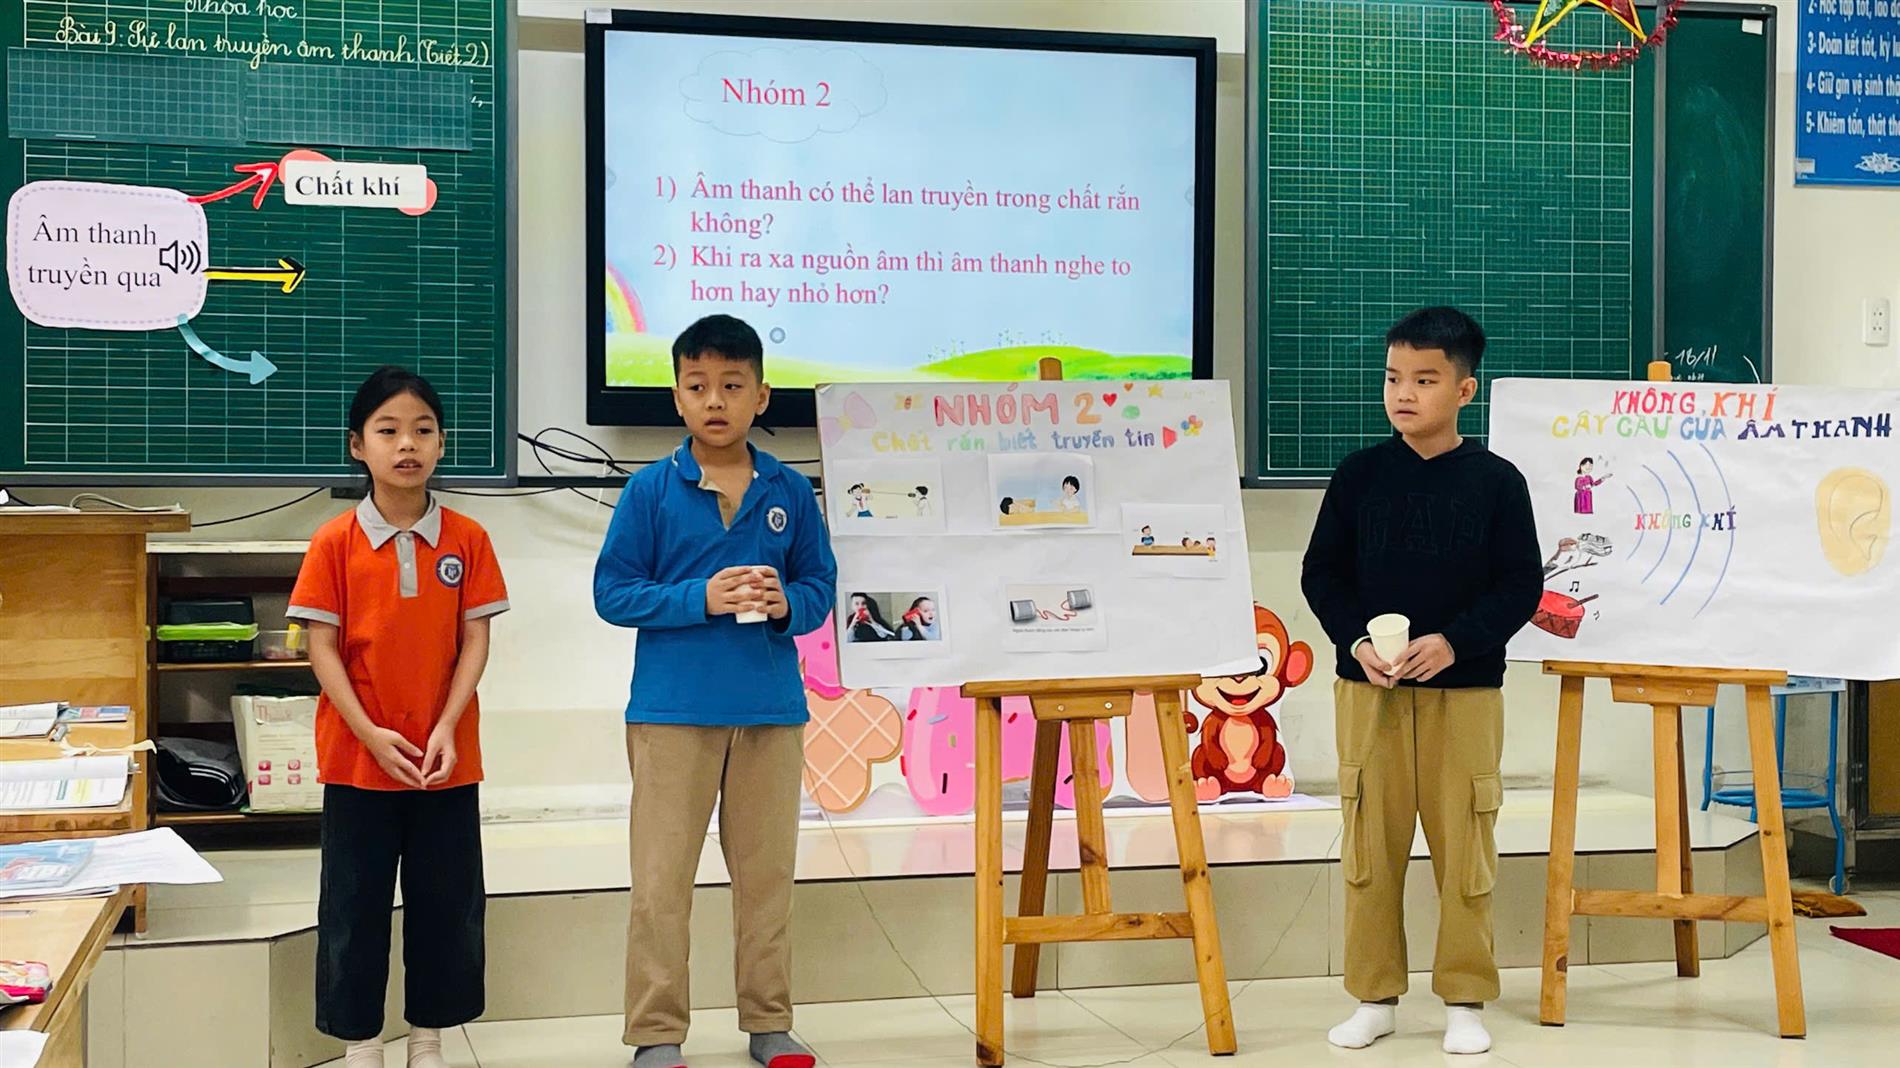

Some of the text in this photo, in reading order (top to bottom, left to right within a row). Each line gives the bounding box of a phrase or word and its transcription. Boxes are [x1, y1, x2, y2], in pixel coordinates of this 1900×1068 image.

[1874, 0, 1889, 17] lao
[56, 16, 101, 45] Bài
[165, 22, 207, 51] lan
[213, 32, 292, 70] truyền
[297, 40, 336, 59] âm
[341, 33, 415, 63] thanh
[463, 40, 489, 67] 2)
[1844, 28, 1859, 56] kết
[721, 78, 831, 107] Nhóm 2
[1865, 73, 1883, 96] sinh
[1817, 110, 1846, 134] Khiêm
[295, 171, 401, 197] Chất khí
[655, 171, 1141, 214] 1) Âm thanh có thể lan truyền trong chất rắn
[32, 214, 157, 246] Âm thanh
[690, 211, 774, 240] không?
[28, 256, 162, 292] truyền qua
[653, 243, 1131, 280] 2) Khi ra xa nguồn âm thì âm thanh nghe to
[690, 279, 889, 308] hơn hay nhỏ hơn?
[934, 383, 1101, 426] NHÓM 2
[1611, 387, 1778, 421] KHÔNG KHÍ
[1125, 428, 1155, 448] tin
[1551, 410, 1610, 439] CÂY
